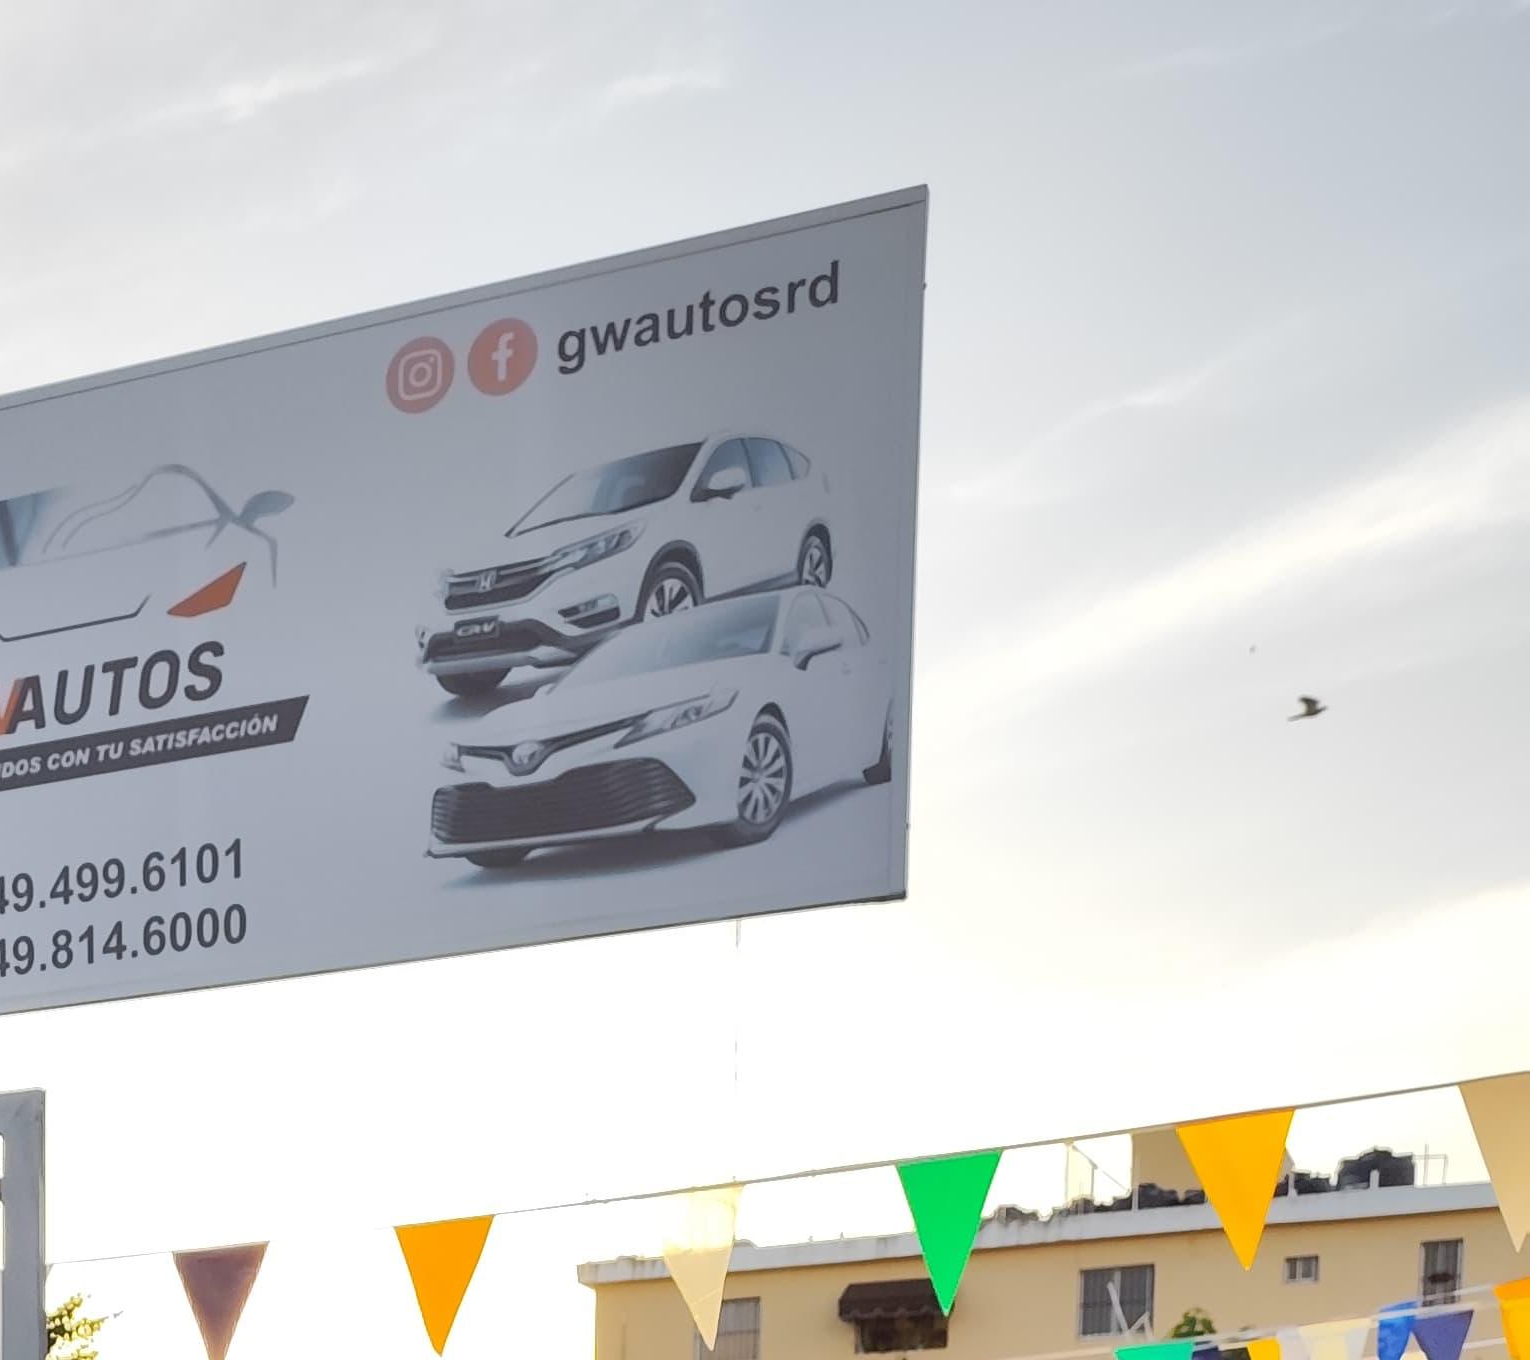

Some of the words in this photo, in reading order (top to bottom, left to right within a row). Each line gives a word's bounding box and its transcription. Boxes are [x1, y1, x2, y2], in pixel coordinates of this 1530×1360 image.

[558, 260, 839, 374] gwautosrd
[47, 748, 89, 771] CON
[97, 742, 123, 763] TU
[129, 713, 279, 757] SATISFACCIÓN
